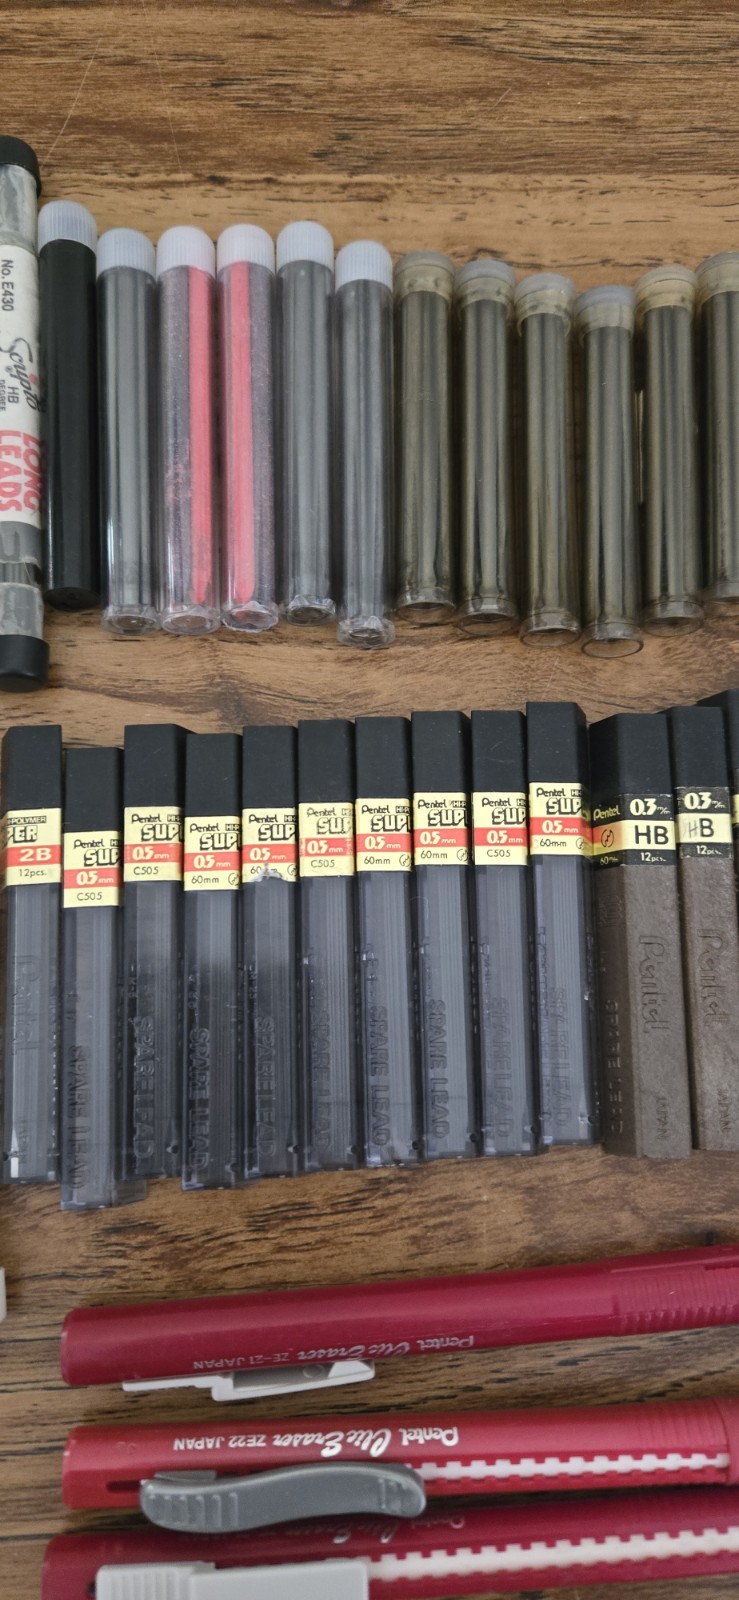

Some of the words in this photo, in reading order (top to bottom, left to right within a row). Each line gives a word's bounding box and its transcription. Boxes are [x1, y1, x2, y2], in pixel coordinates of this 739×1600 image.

[1, 259, 14, 280] No.
[1, 281, 14, 312] E430
[7, 386, 20, 405] HB
[0, 429, 22, 512] LEADS
[536, 787, 566, 798] Pentel
[417, 799, 447, 809] Pentel
[481, 797, 511, 807] Pentel
[306, 807, 337, 818] Pentel
[361, 804, 390, 815] Pentel
[593, 805, 621, 821] Pentel
[131, 813, 162, 824] Pentel
[248, 813, 279, 824] Pentel
[189, 823, 220, 833] Pentel
[688, 817, 715, 838] HB
[634, 824, 669, 845] HB
[73, 838, 105, 850] Pentel
[539, 838, 567, 847] 60mm
[19, 847, 52, 863] 2B
[420, 850, 448, 860] 60mm
[486, 849, 511, 858] C505
[310, 859, 336, 868] C505
[363, 855, 391, 865] 60mm
[19, 868, 47, 879] 12pcs.
[133, 866, 159, 875] C505
[191, 875, 220, 884] 60mm
[76, 891, 103, 902] C505
[416, 1335, 475, 1351] Pentel
[192, 1357, 248, 1370] JAPAN
[227, 1433, 267, 1448] ZE22
[398, 1426, 459, 1447] Pentel
[173, 1434, 225, 1451] JAPAN
[272, 1430, 345, 1458] Eraser
[346, 1428, 392, 1458] Clic
